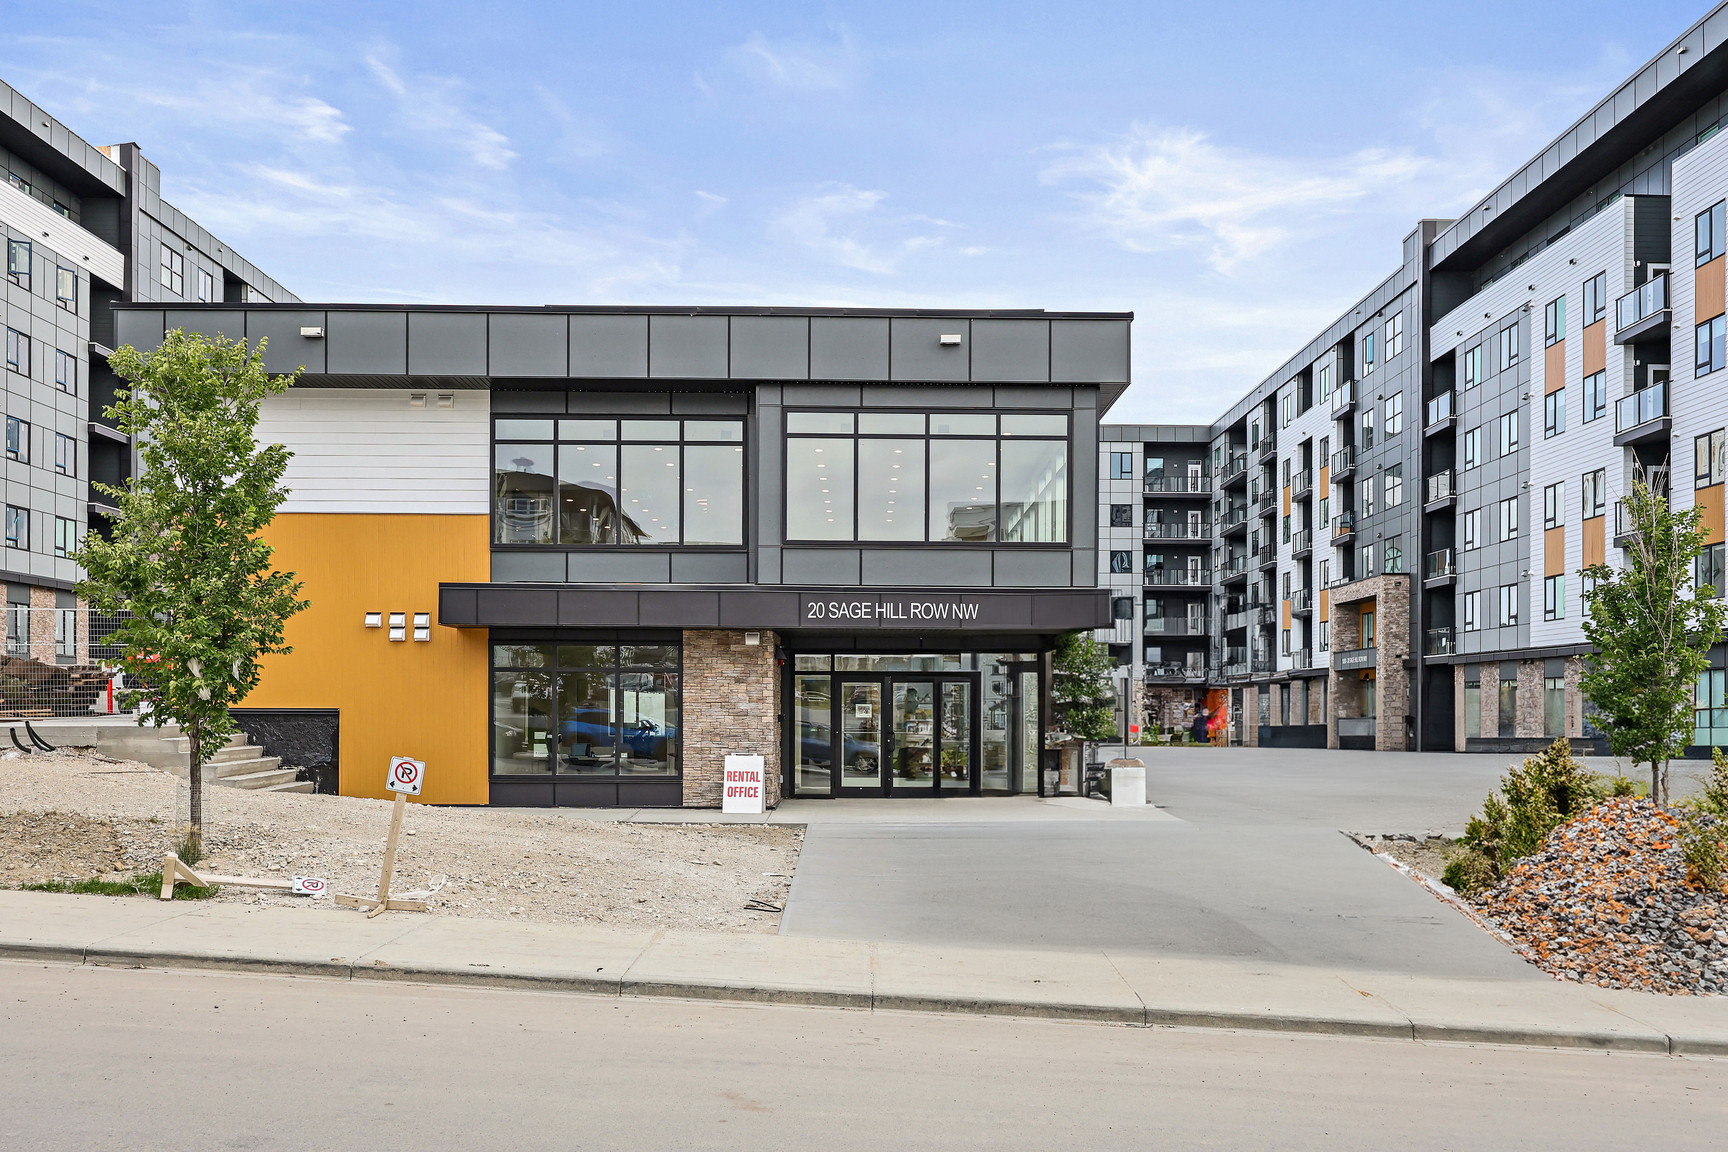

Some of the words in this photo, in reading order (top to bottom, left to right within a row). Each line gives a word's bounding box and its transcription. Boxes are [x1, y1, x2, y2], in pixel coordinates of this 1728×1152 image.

[807, 602, 825, 619] 20
[828, 602, 872, 619] SAGE
[876, 602, 907, 619] HILL
[910, 602, 949, 619] ROW
[952, 603, 979, 619] NW
[726, 770, 761, 782] RENTAL
[727, 786, 759, 798] OFFICE
